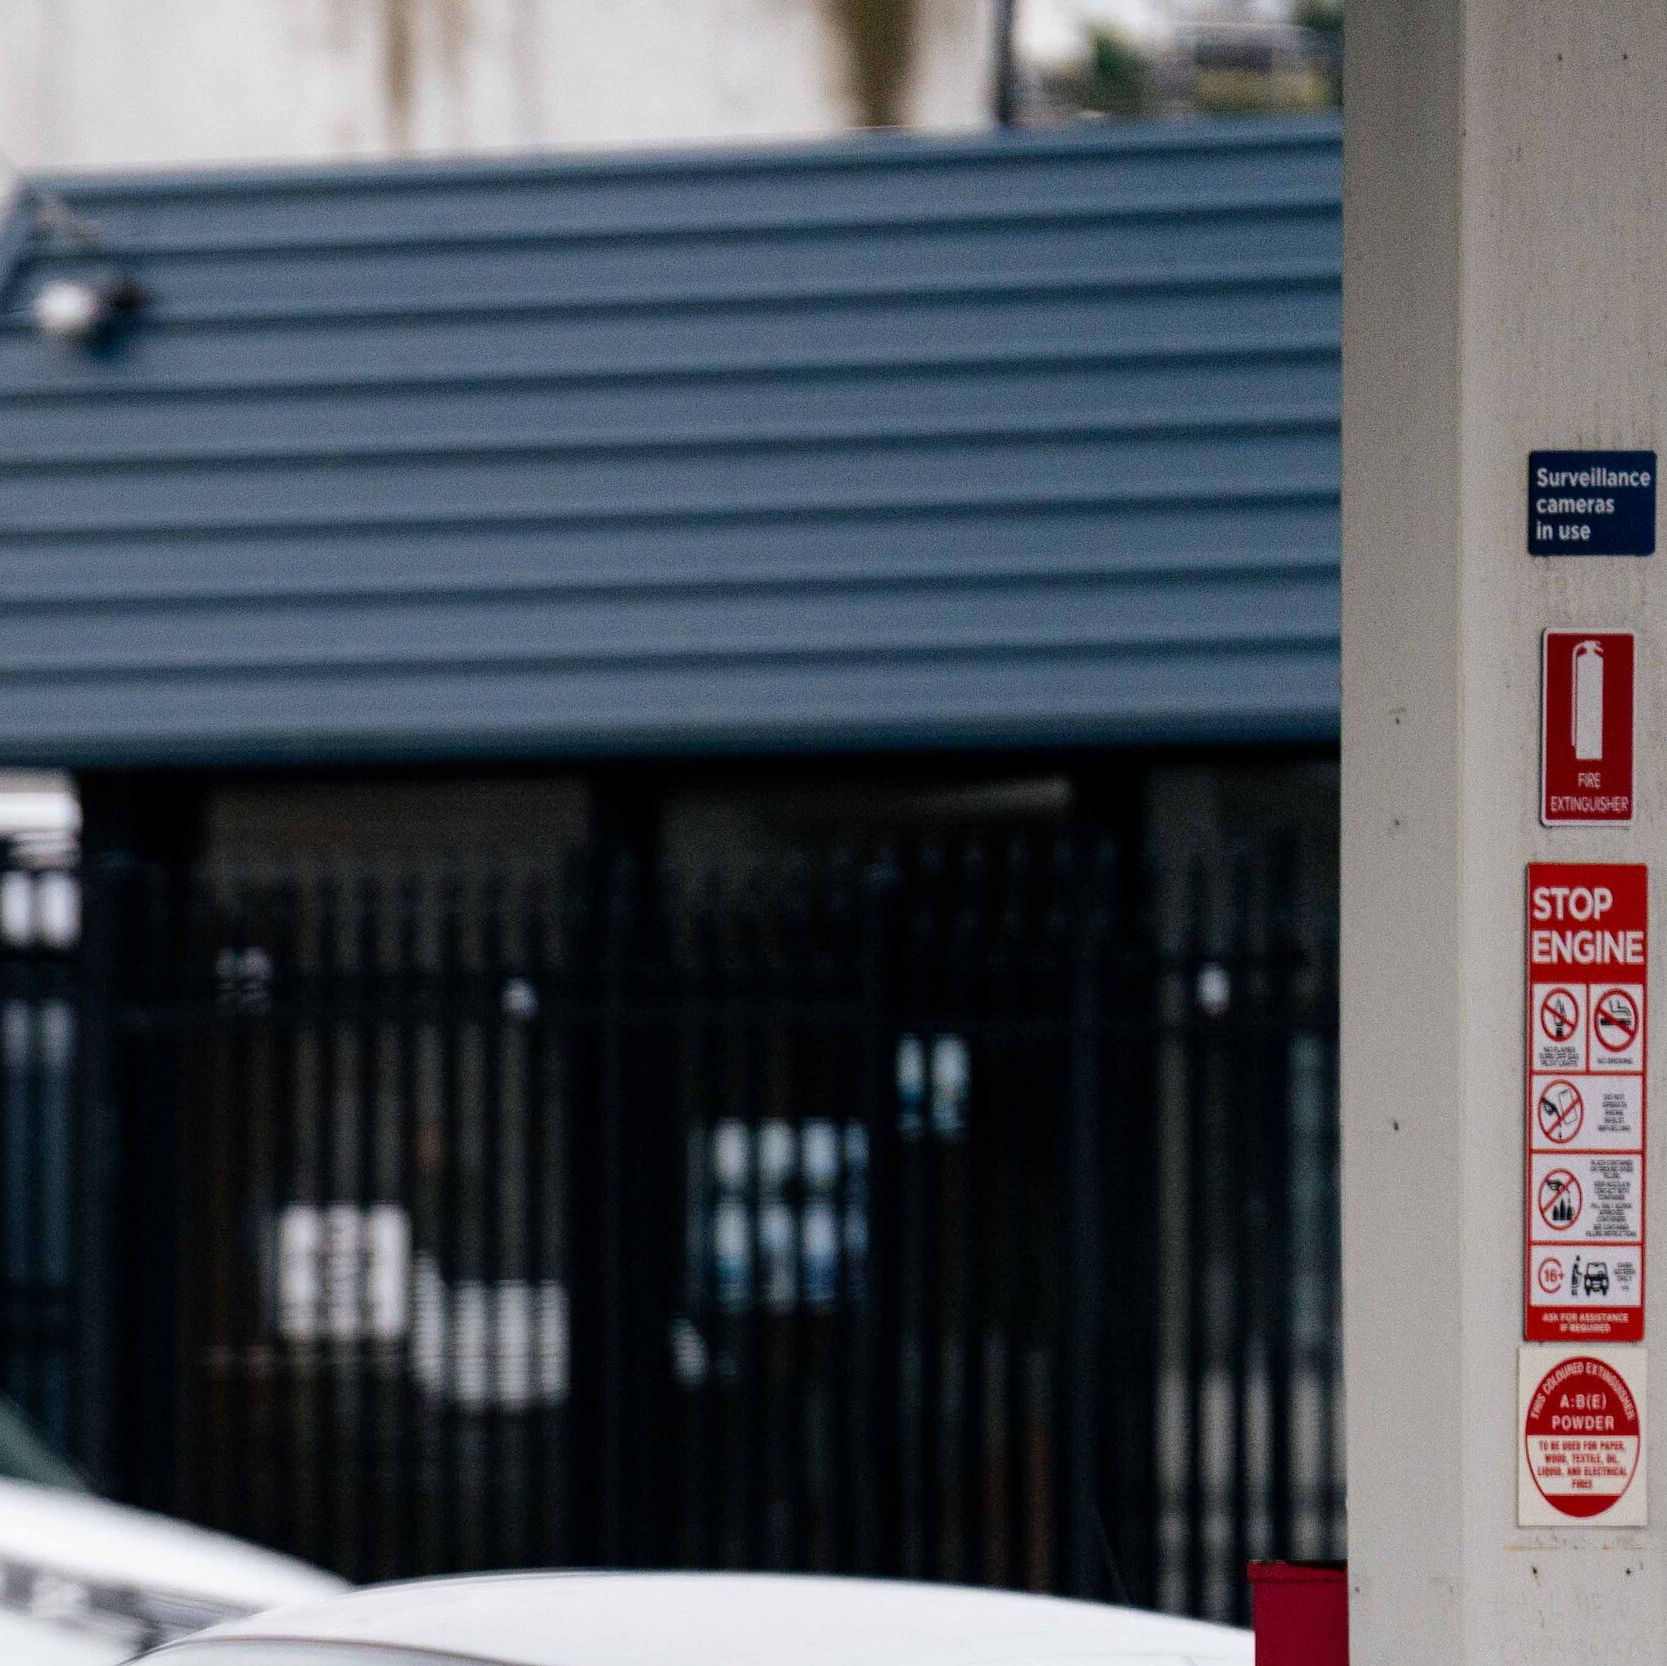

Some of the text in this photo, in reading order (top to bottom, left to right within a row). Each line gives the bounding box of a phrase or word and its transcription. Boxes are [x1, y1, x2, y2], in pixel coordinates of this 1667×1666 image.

[1536, 467, 1651, 488] Surveillance
[1536, 496, 1615, 514] cameras
[1536, 520, 1591, 540] in use
[1577, 772, 1601, 787] FIRE
[1550, 796, 1629, 812] EXTINGUISHER
[1533, 886, 1613, 921] STOP
[1532, 930, 1644, 964] ENGINE
[1545, 1269, 1564, 1282] 16+
[1560, 1312, 1578, 1322] FOR
[1551, 1415, 1615, 1431] POWDER
